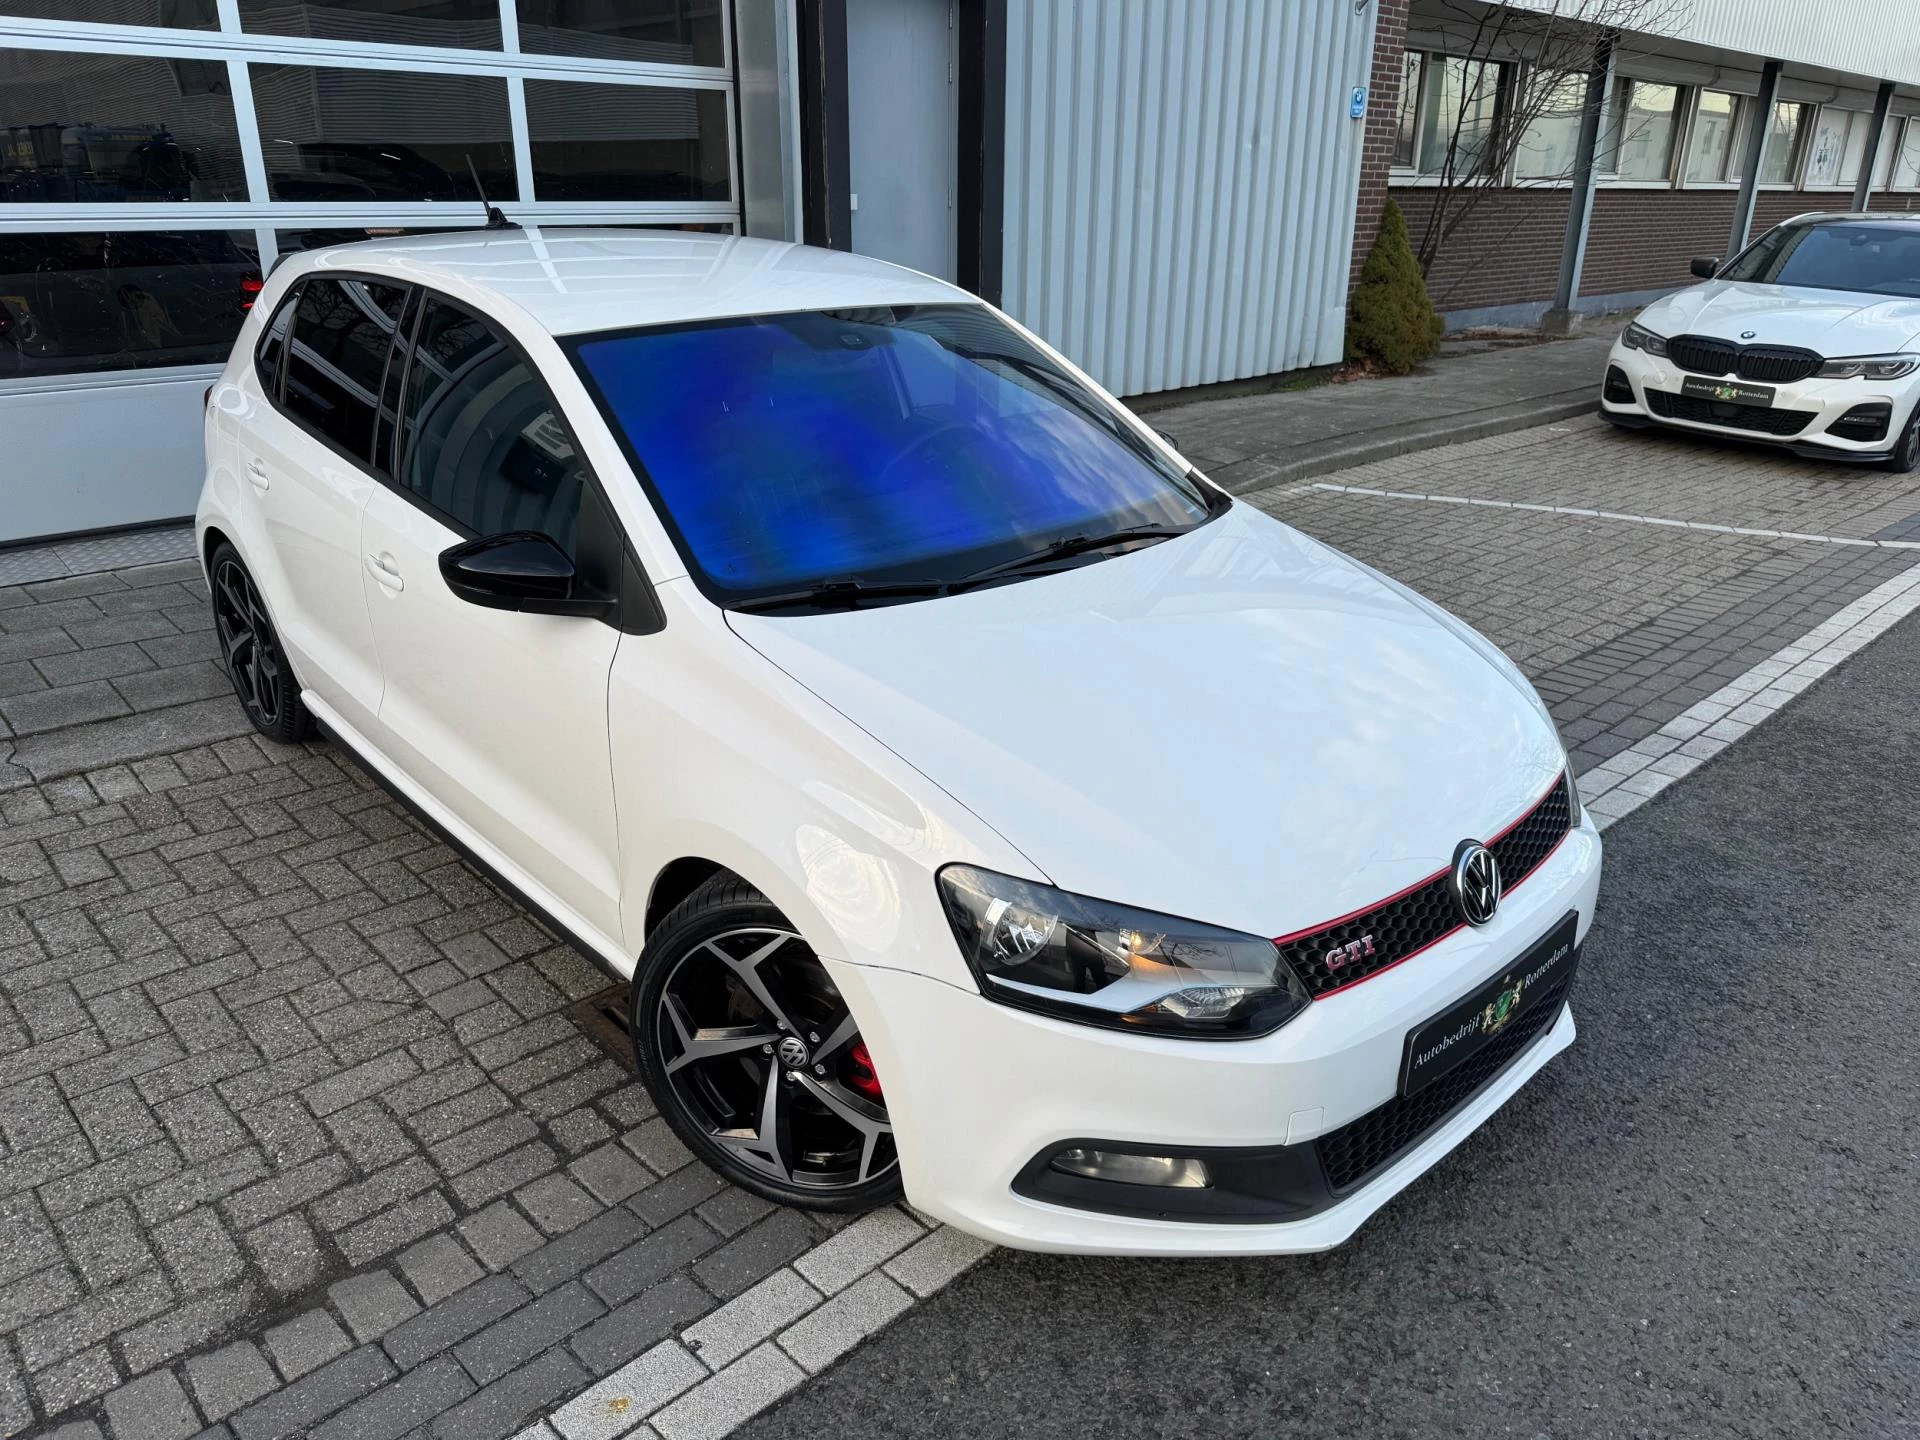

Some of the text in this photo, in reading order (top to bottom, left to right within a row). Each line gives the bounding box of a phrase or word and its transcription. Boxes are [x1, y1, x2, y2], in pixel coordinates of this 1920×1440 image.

[1325, 934, 1376, 971] GTI
[1414, 943, 1569, 1070] Autobedrijf Rotterdam
